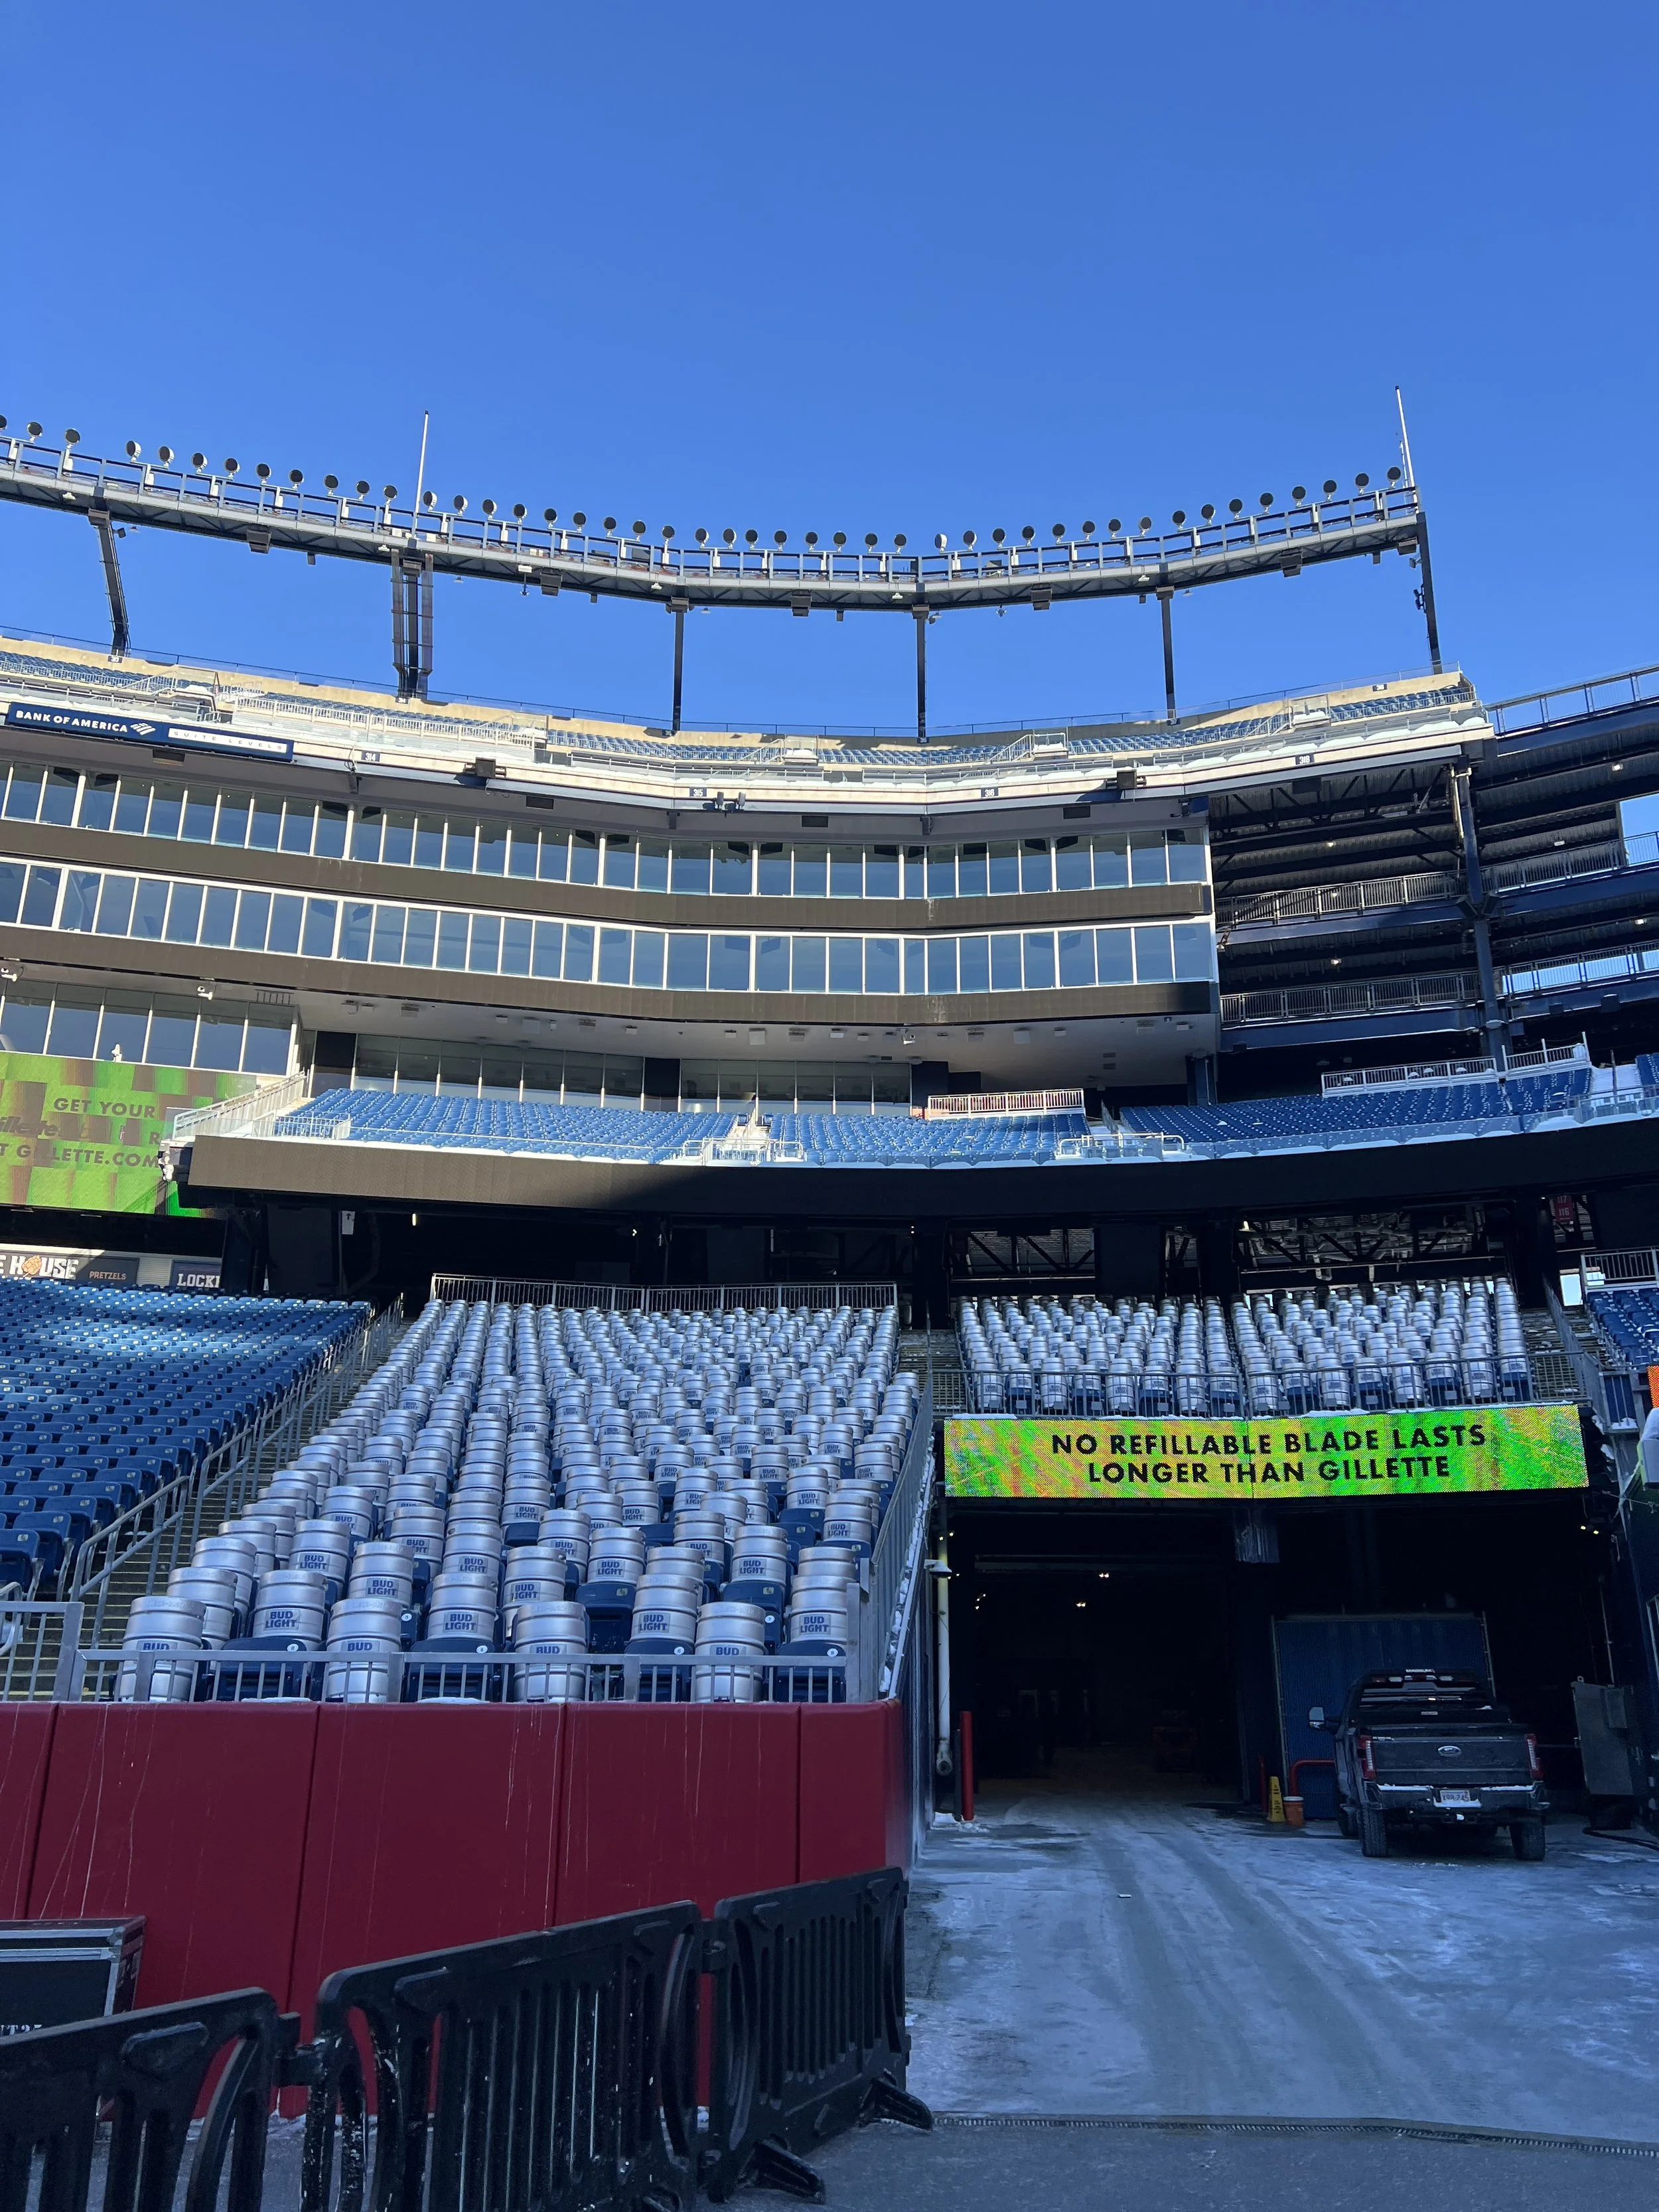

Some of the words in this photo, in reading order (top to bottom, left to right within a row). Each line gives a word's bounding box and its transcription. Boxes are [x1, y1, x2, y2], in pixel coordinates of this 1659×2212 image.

[17, 710, 51, 722] BANK
[53, 715, 70, 724] OF
[72, 718, 128, 733] AMERICA
[174, 731, 216, 741] SUITE
[229, 739, 283, 750] LEVELS
[365, 752, 376, 761] 314
[1299, 755, 1311, 764] 318
[53, 1098, 92, 1113] GET
[100, 1101, 155, 1118] YOUR
[89, 1271, 127, 1281] PRETZELS
[1052, 1434, 1098, 1454] NO
[1111, 1434, 1271, 1455] REFILLABLE
[1284, 1430, 1379, 1453] BLADE
[1393, 1424, 1486, 1450] LASTS
[1088, 1462, 1209, 1484] LONGER
[1220, 1460, 1305, 1484] THAN
[1318, 1455, 1449, 1481] GILLETTE
[459, 1564, 486, 1573] LIGHT
[740, 1566, 764, 1575] LIGHT
[368, 1587, 397, 1595] LIGHT
[512, 1591, 539, 1599] LIGHT
[644, 1614, 664, 1623] BUD
[804, 1616, 824, 1625] BUD
[265, 1619, 297, 1628] LIGHT
[445, 1621, 476, 1631] LIGHT
[640, 1622, 668, 1631] LIGHT
[800, 1624, 829, 1633] LIGHT
[348, 1643, 372, 1652] BUD
[536, 1646, 560, 1655] BUD
[716, 1647, 739, 1656] BUD
